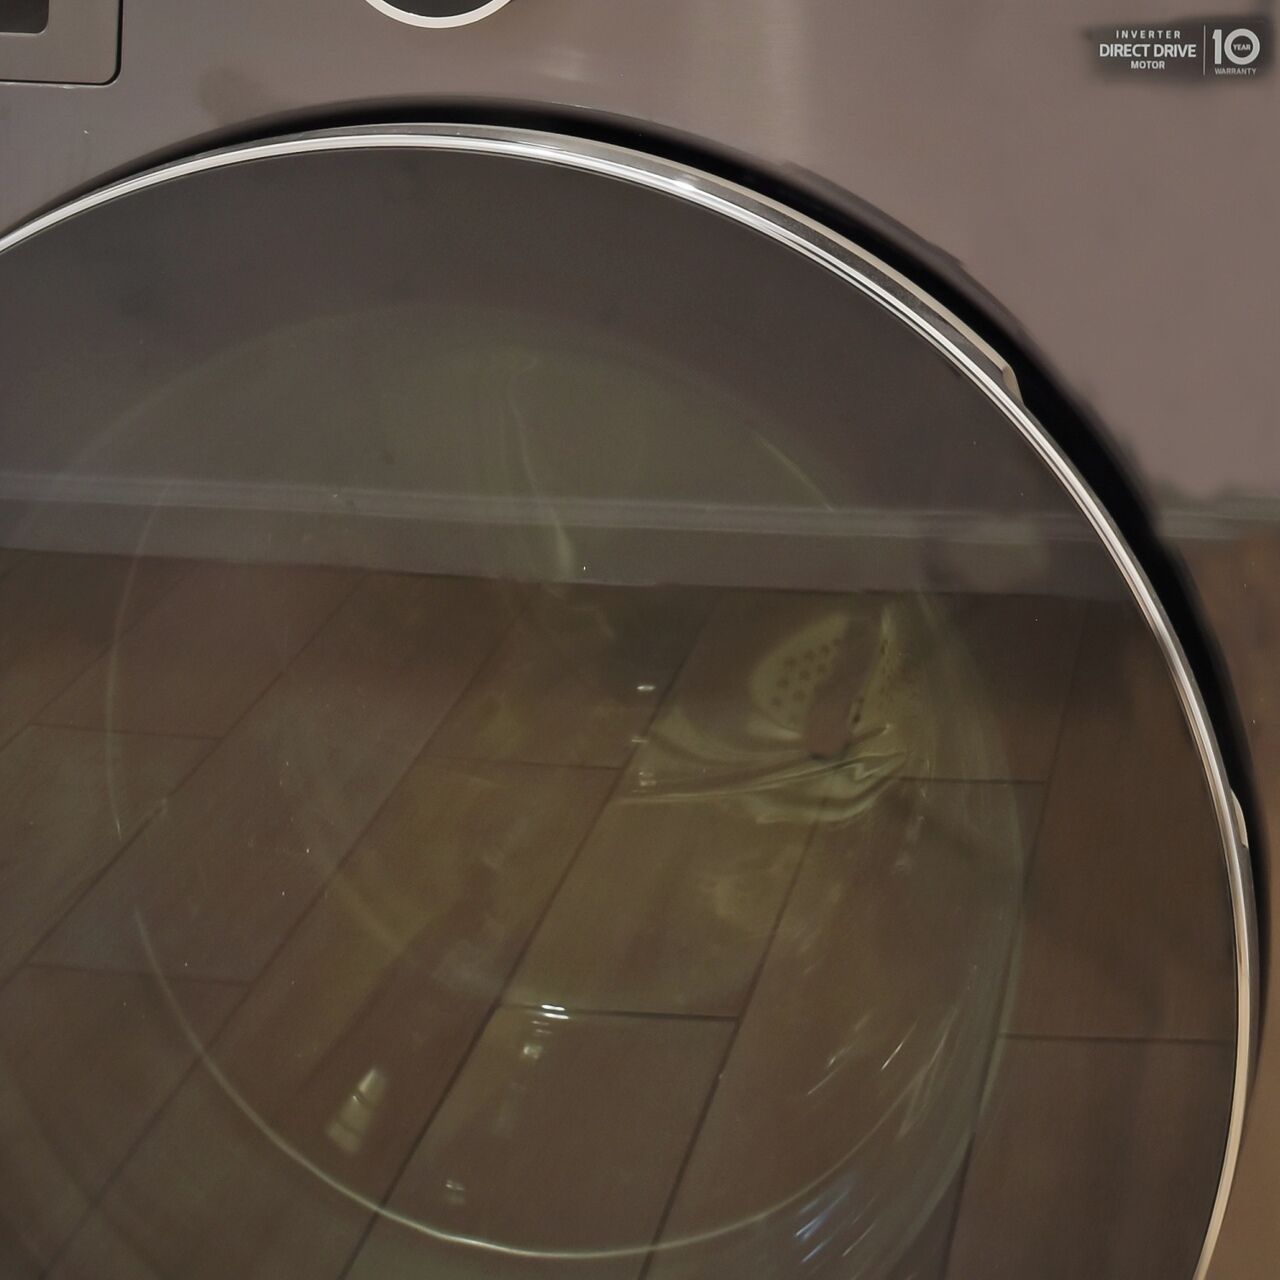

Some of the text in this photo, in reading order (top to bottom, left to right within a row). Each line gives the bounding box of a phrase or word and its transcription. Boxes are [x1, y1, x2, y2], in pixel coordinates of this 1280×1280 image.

[1115, 29, 1182, 40] INVERTER
[1099, 43, 1197, 58] DIRECT DRIVE
[1212, 28, 1261, 65] 10
[1232, 43, 1251, 51] YEAR
[1130, 60, 1166, 70] MOTOR
[1214, 67, 1257, 76] WARRANTY
